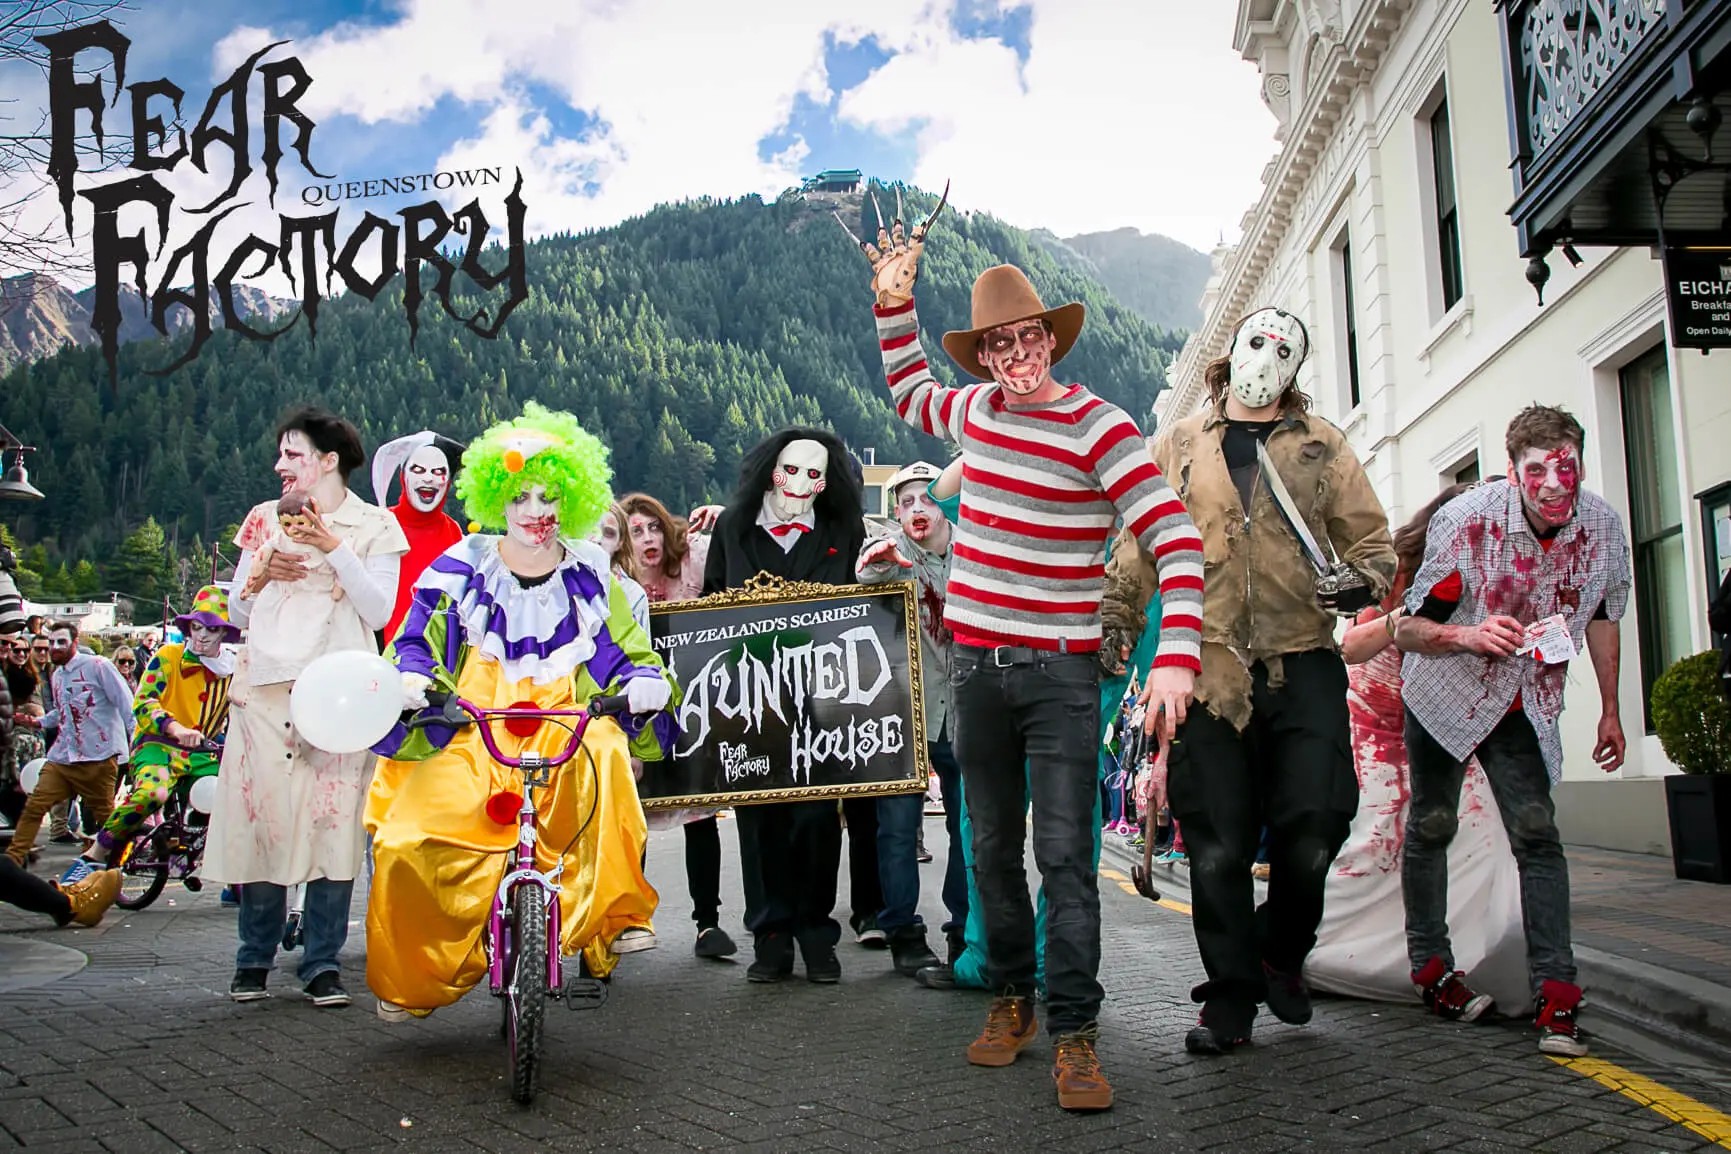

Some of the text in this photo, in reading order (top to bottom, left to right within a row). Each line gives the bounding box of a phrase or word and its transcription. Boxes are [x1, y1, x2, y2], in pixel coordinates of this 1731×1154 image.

[1686, 327, 1710, 336] Open
[1711, 312, 1730, 321] and
[653, 603, 872, 651] NEW ZEALAND'S SCARIEST
[667, 625, 893, 761] AUNTED
[718, 741, 748, 767] FEAR
[789, 713, 904, 785] HOUSE
[724, 754, 770, 784] FACTORY
